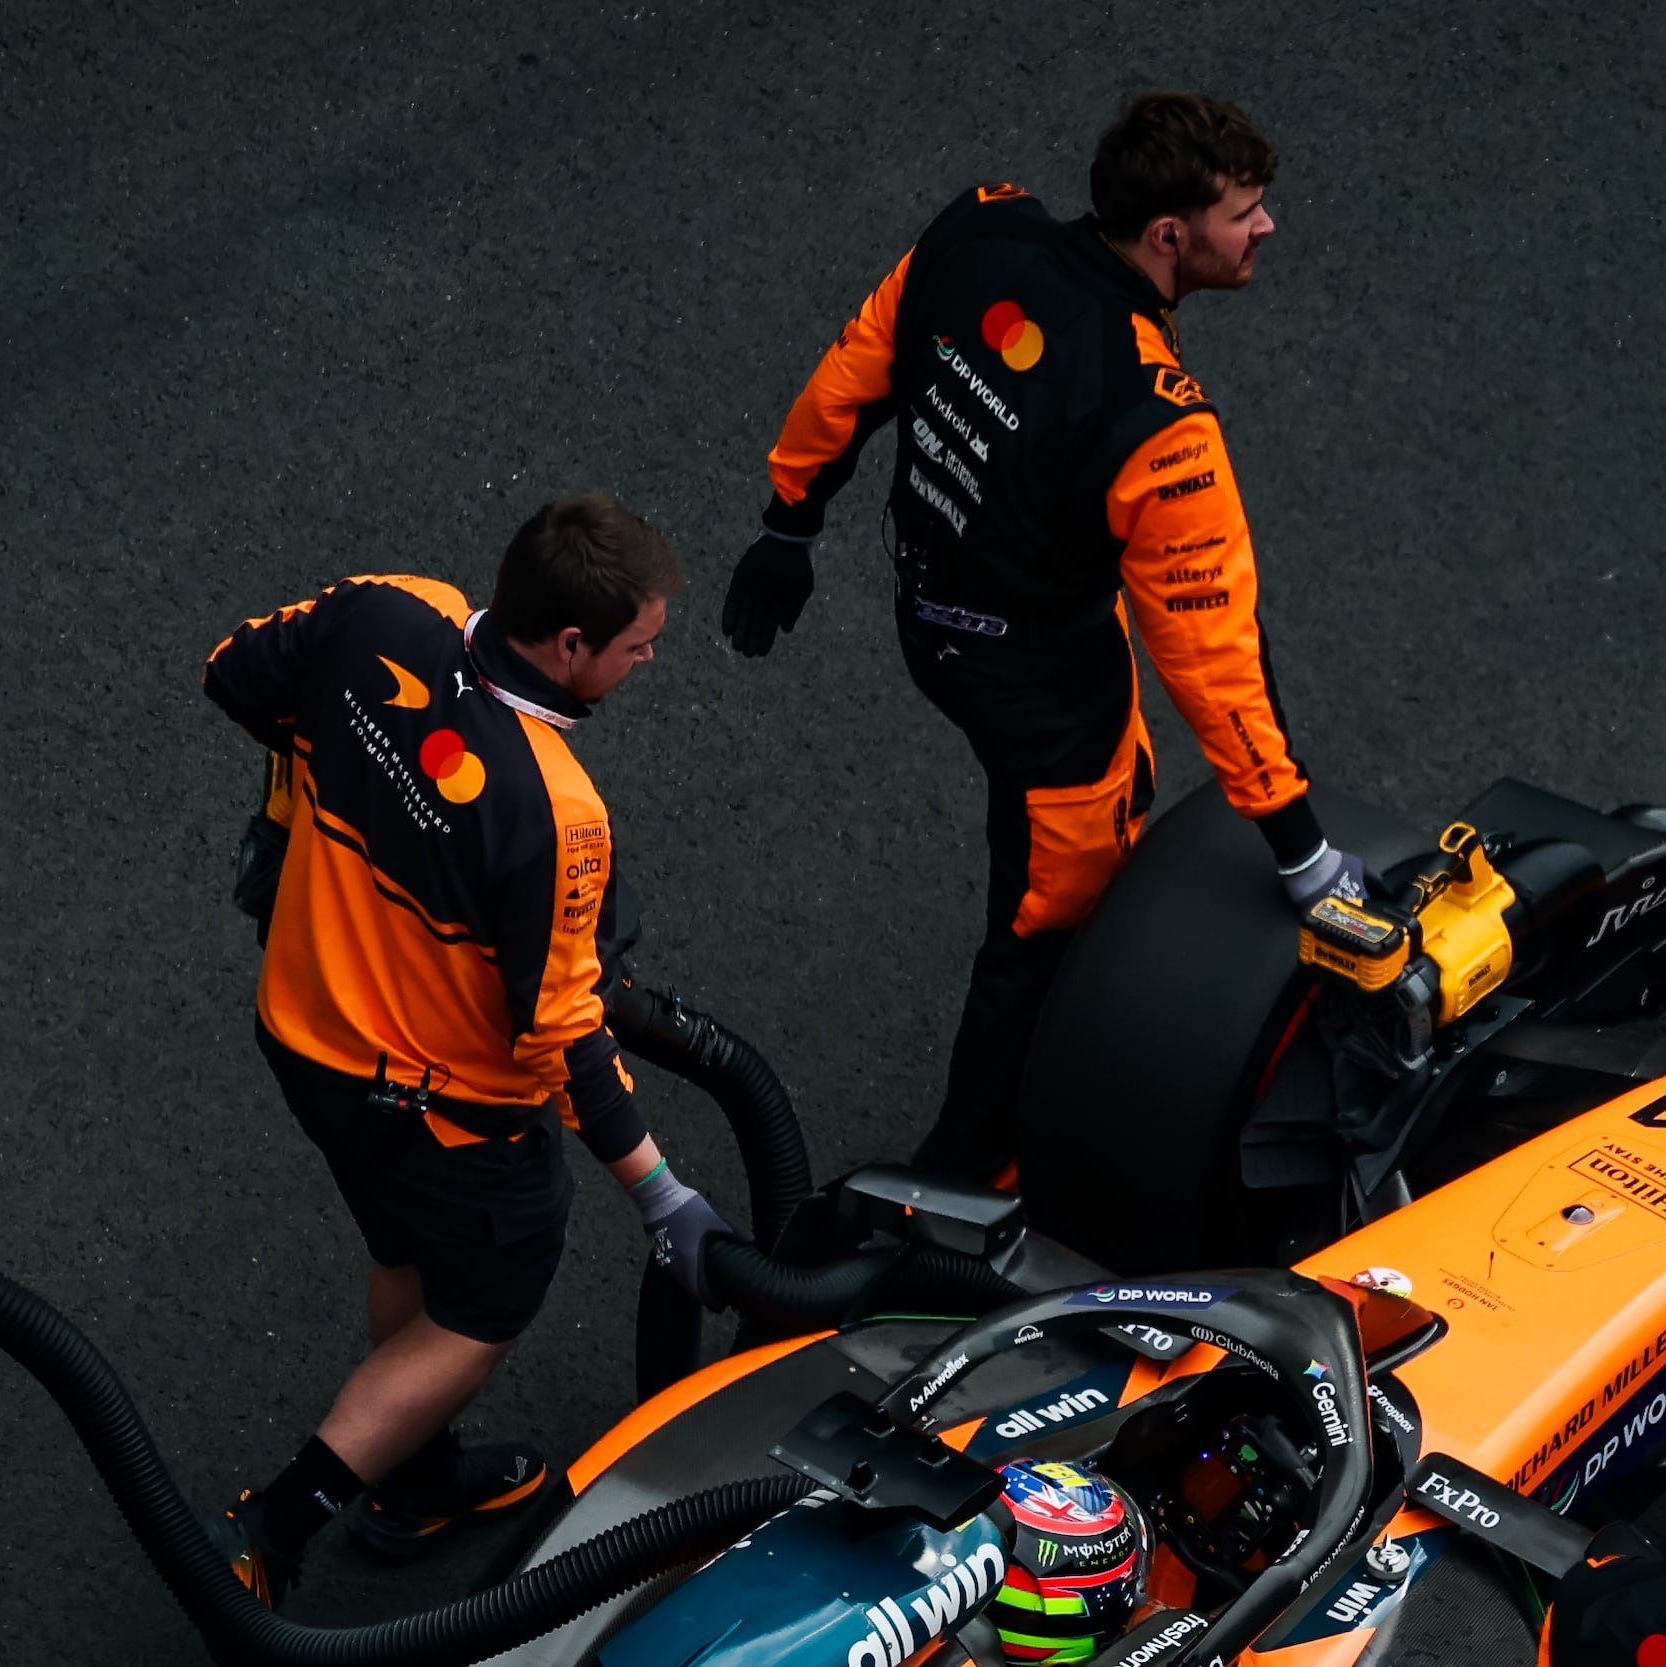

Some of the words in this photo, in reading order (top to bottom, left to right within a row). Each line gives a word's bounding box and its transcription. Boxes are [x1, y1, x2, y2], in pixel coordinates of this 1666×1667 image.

[925, 382, 973, 441] Android
[950, 354, 971, 379] DP
[969, 373, 1020, 432] WORLD
[1165, 564, 1223, 586] alteryx
[1604, 1143, 1643, 1164] STAY
[1118, 1288, 1143, 1303] DP
[1146, 1289, 1212, 1304] WORLD
[921, 1352, 970, 1401] Airwallex
[1216, 1333, 1281, 1381] ClubAvolta
[995, 1406, 1036, 1441] all
[1039, 1384, 1110, 1429] win
[1313, 1381, 1354, 1448] Gemini
[1376, 1388, 1415, 1435] Dropbox
[1581, 1436, 1621, 1488] DP
[1416, 1472, 1502, 1530] FxPro
[1063, 1526, 1132, 1559] MONSTER
[917, 1541, 1006, 1634] win
[1325, 1580, 1382, 1623] win
